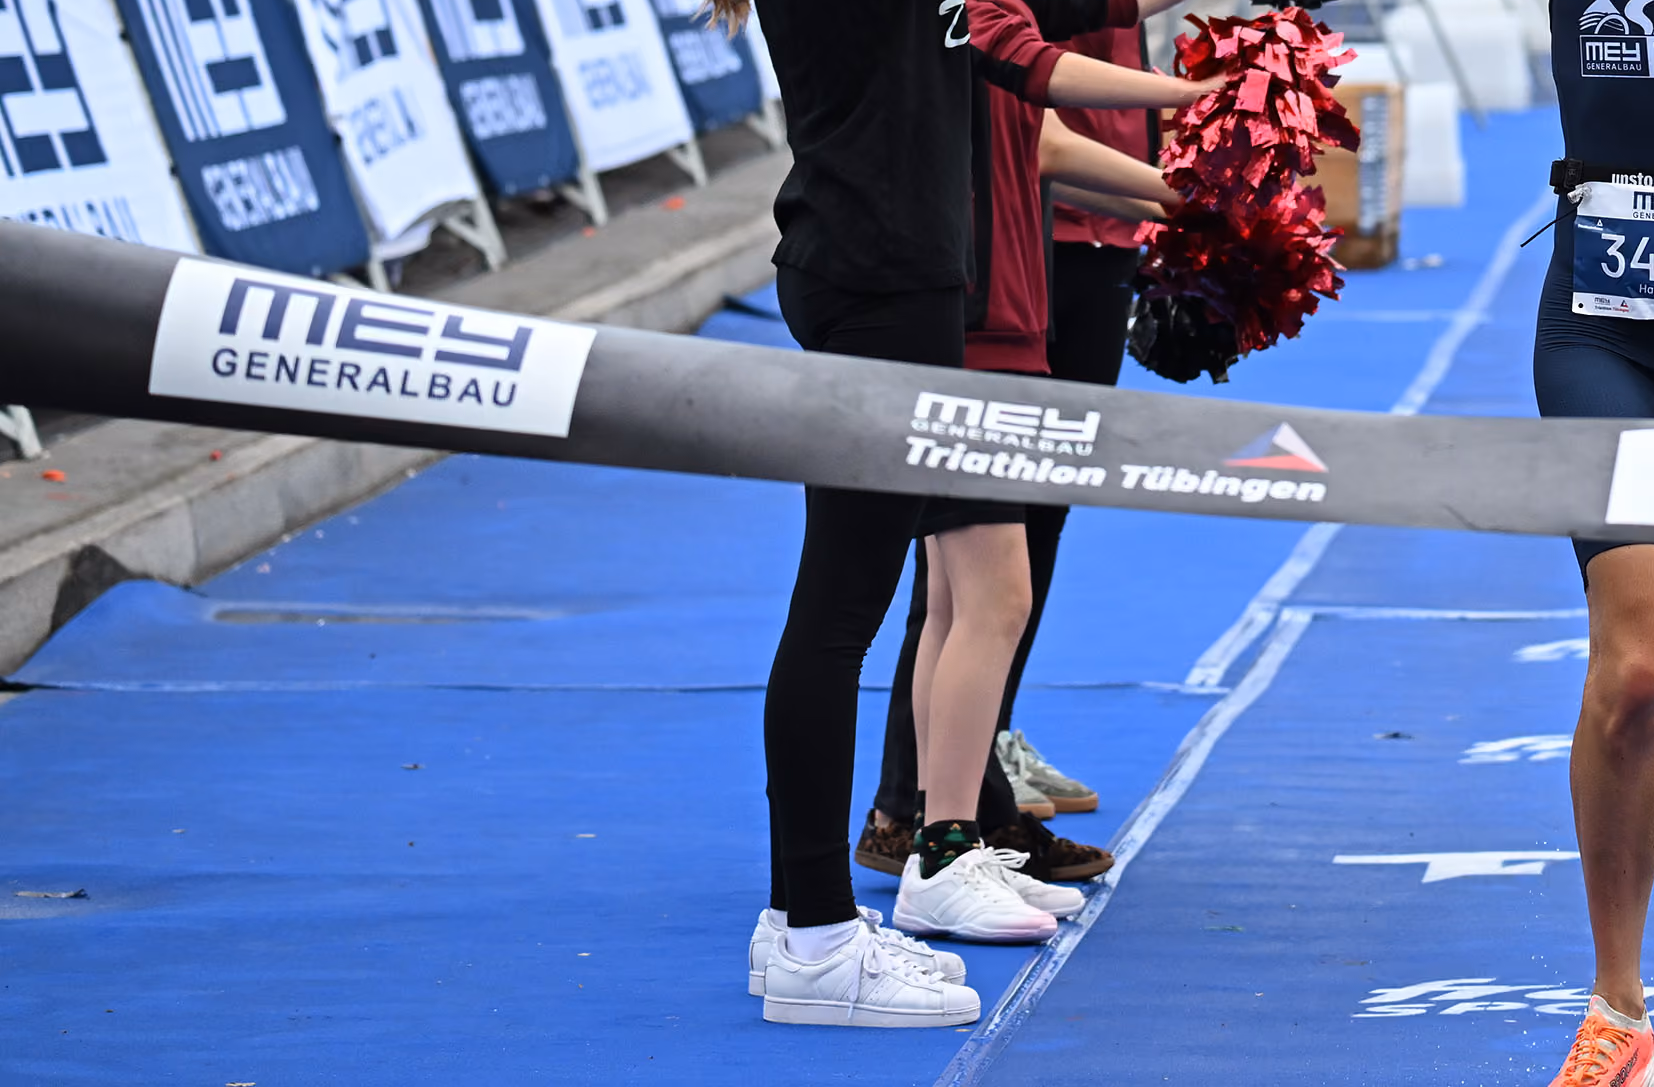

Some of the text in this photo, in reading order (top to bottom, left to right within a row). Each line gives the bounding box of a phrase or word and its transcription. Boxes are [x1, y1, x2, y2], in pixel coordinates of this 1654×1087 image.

[1585, 41, 1641, 61] MEY
[1586, 62, 1642, 72] GENERALBAU
[218, 277, 534, 372] MEY
[211, 347, 518, 408] GENERALBAU
[910, 419, 1094, 458] GENERALBAU
[913, 391, 1101, 443] MEY
[905, 435, 1328, 504] Triathlon Tübingen
